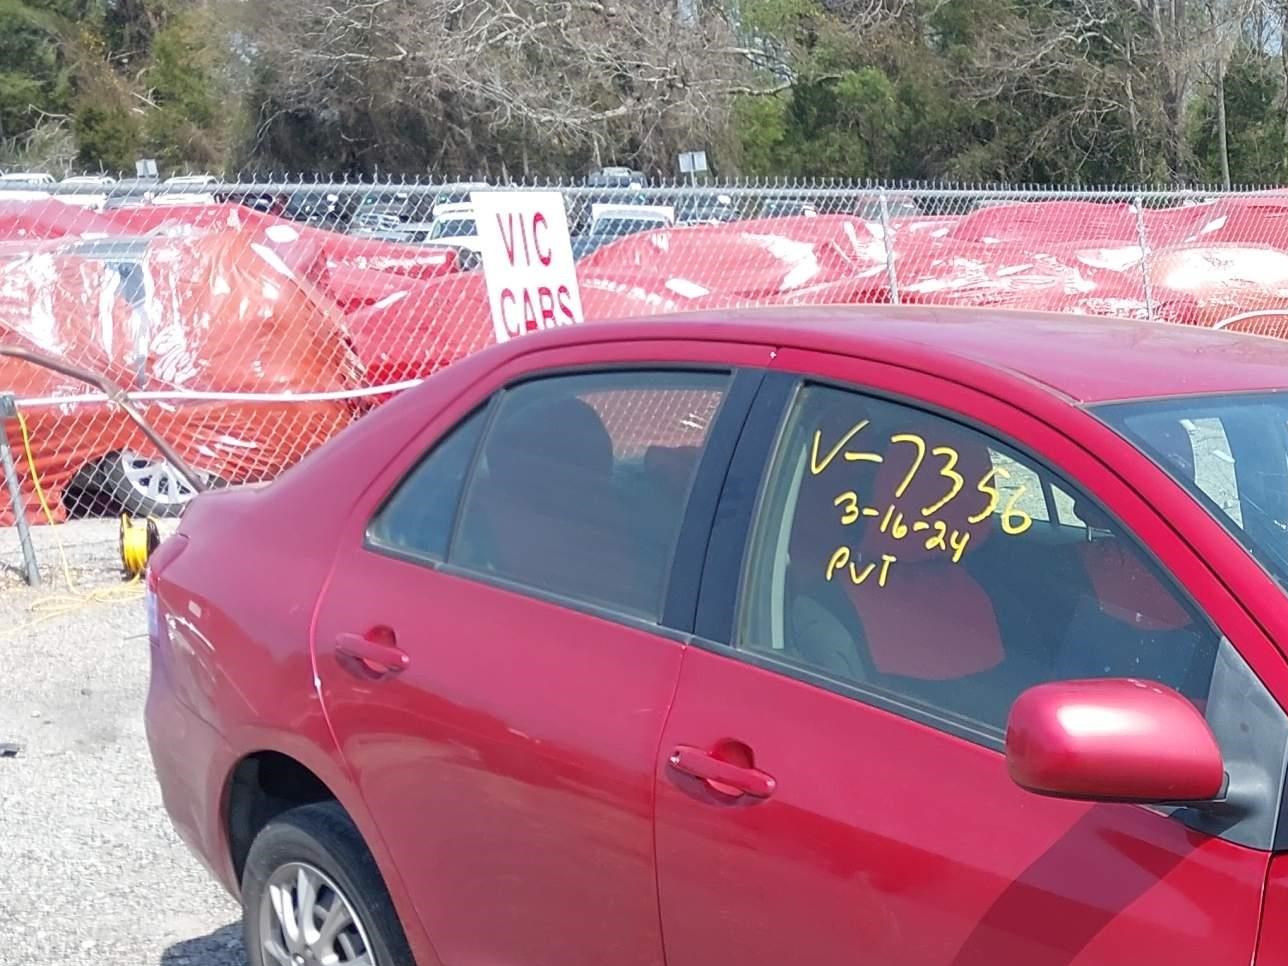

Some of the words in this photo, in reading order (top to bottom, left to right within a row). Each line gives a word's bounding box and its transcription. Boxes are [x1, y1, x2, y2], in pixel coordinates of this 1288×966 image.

[495, 211, 552, 267] VIC
[501, 285, 577, 338] CARS
[834, 491, 970, 563] 3-16-24
